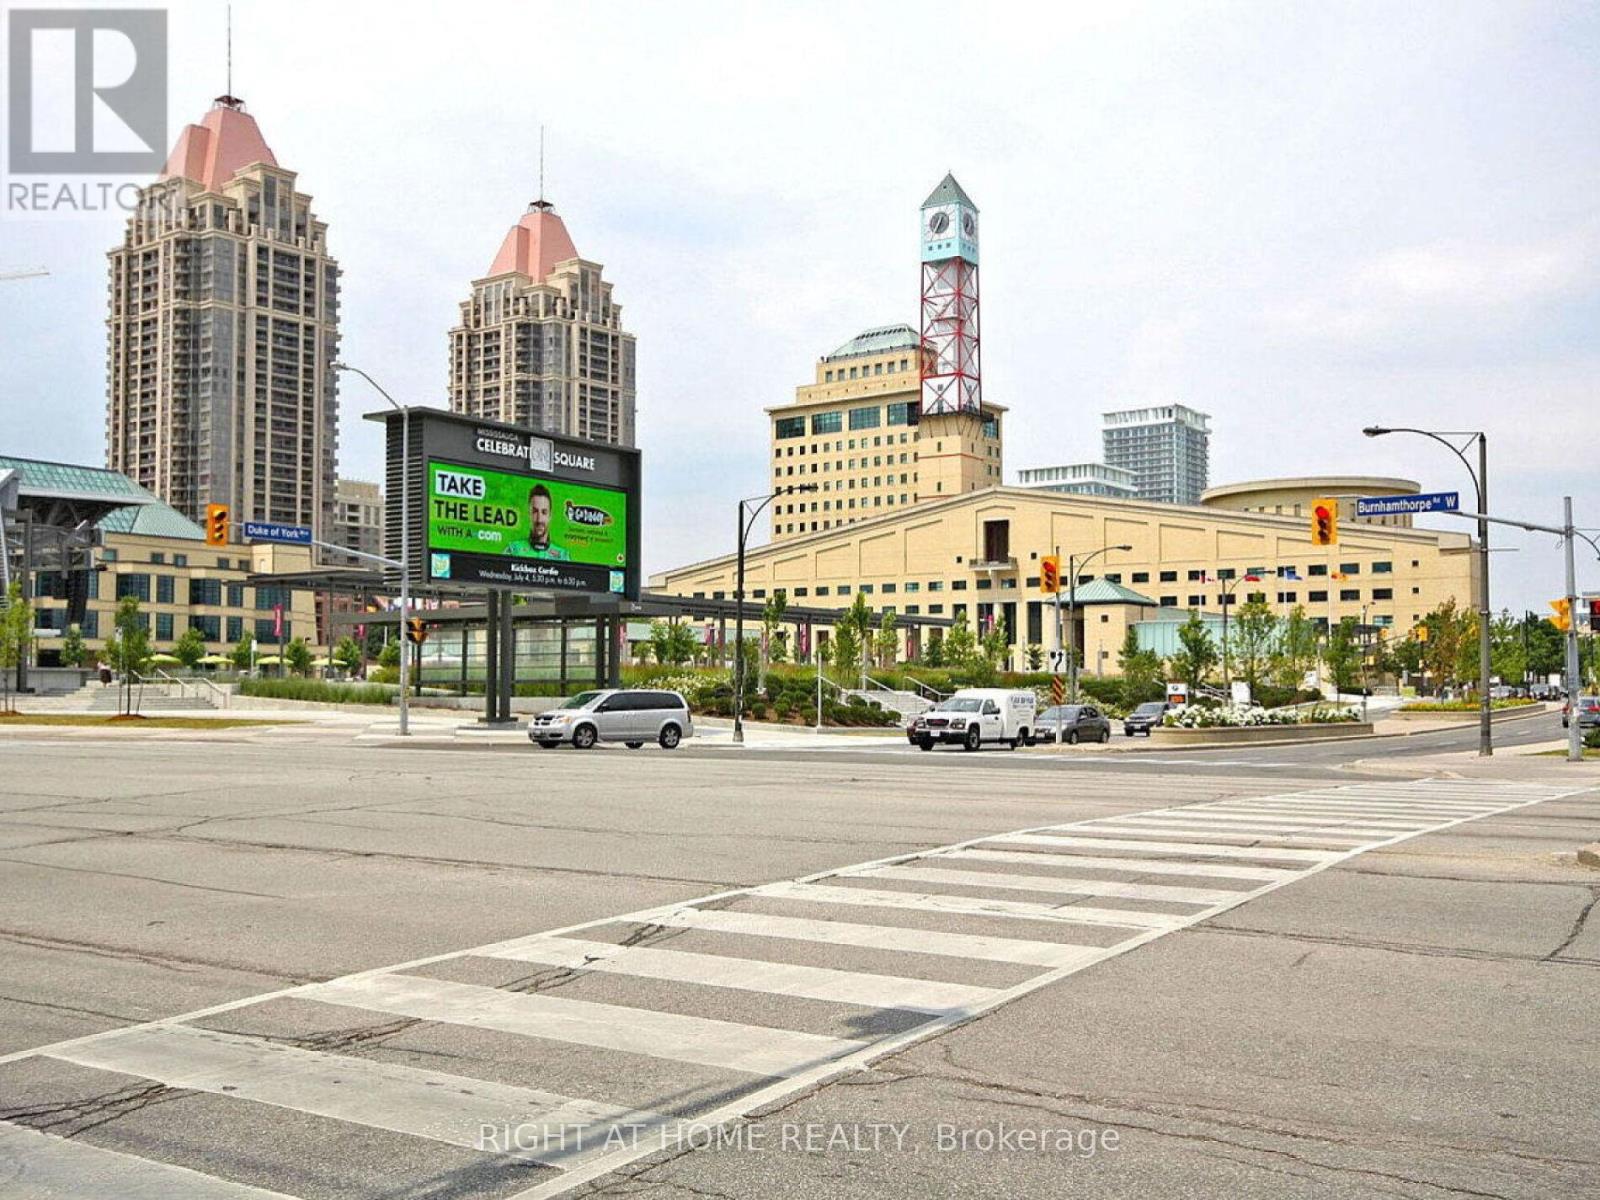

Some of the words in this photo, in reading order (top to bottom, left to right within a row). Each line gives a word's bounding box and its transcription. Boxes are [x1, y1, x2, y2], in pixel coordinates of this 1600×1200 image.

[553, 452, 596, 471] SQUARE
[438, 473, 482, 497] TAKE
[434, 499, 469, 521] THE
[474, 505, 518, 527] LEAD
[1359, 499, 1432, 513] Burnhamthorpe
[1445, 495, 1456, 507] W
[247, 525, 269, 536] Duke
[271, 527, 279, 537] of
[281, 528, 299, 538] York
[437, 525, 463, 538] WITH
[464, 528, 473, 538] A
